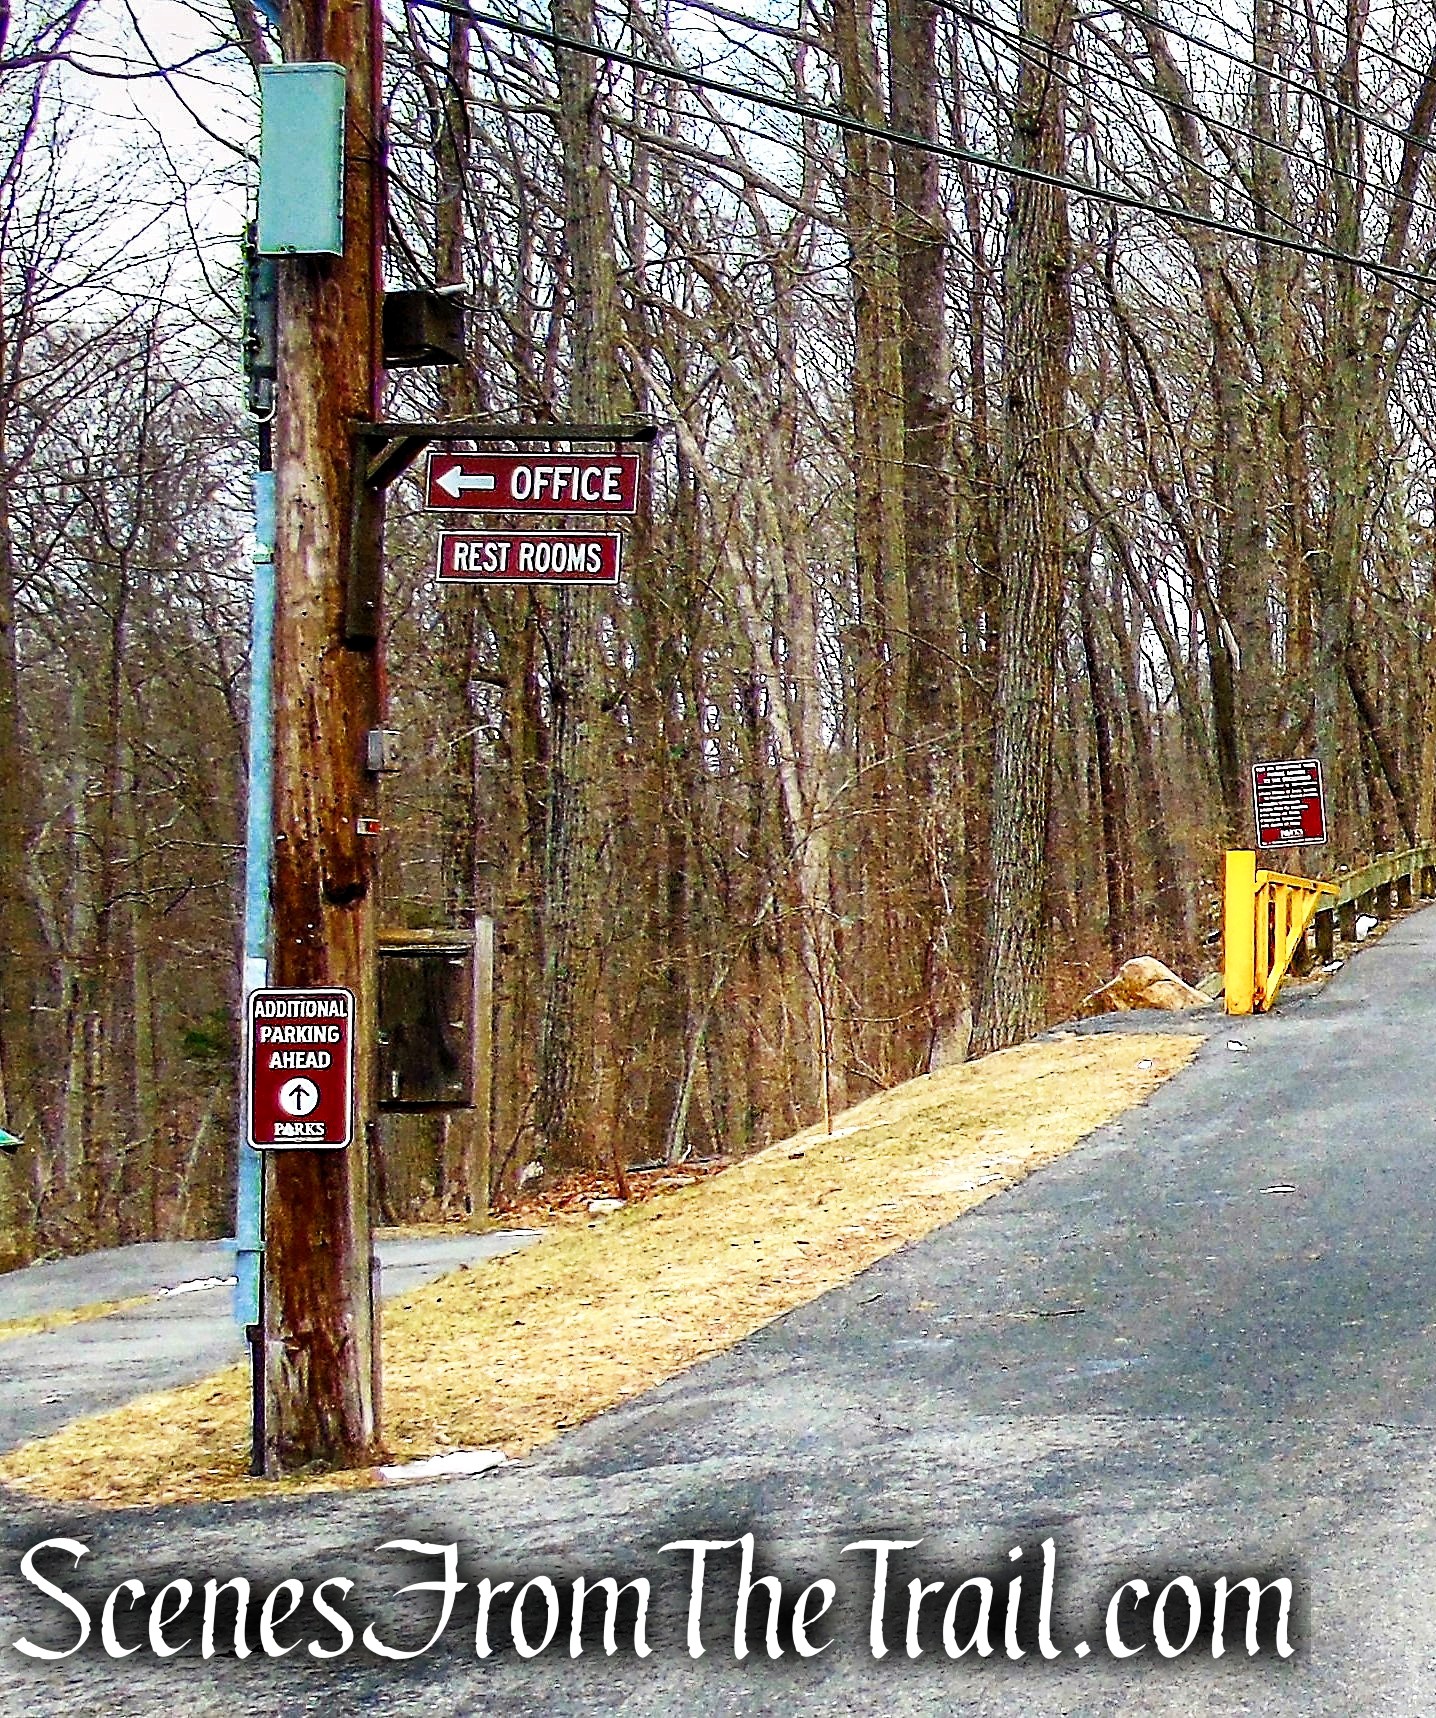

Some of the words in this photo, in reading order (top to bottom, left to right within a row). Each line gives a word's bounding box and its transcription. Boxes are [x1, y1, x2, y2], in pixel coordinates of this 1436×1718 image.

[510, 466, 622, 501] OFFICE
[454, 542, 511, 572] REST
[519, 543, 602, 573] ROOMS
[254, 1000, 348, 1019] ADDITIONAL
[260, 1025, 340, 1043] PARKING
[269, 1051, 331, 1069] AHEAD
